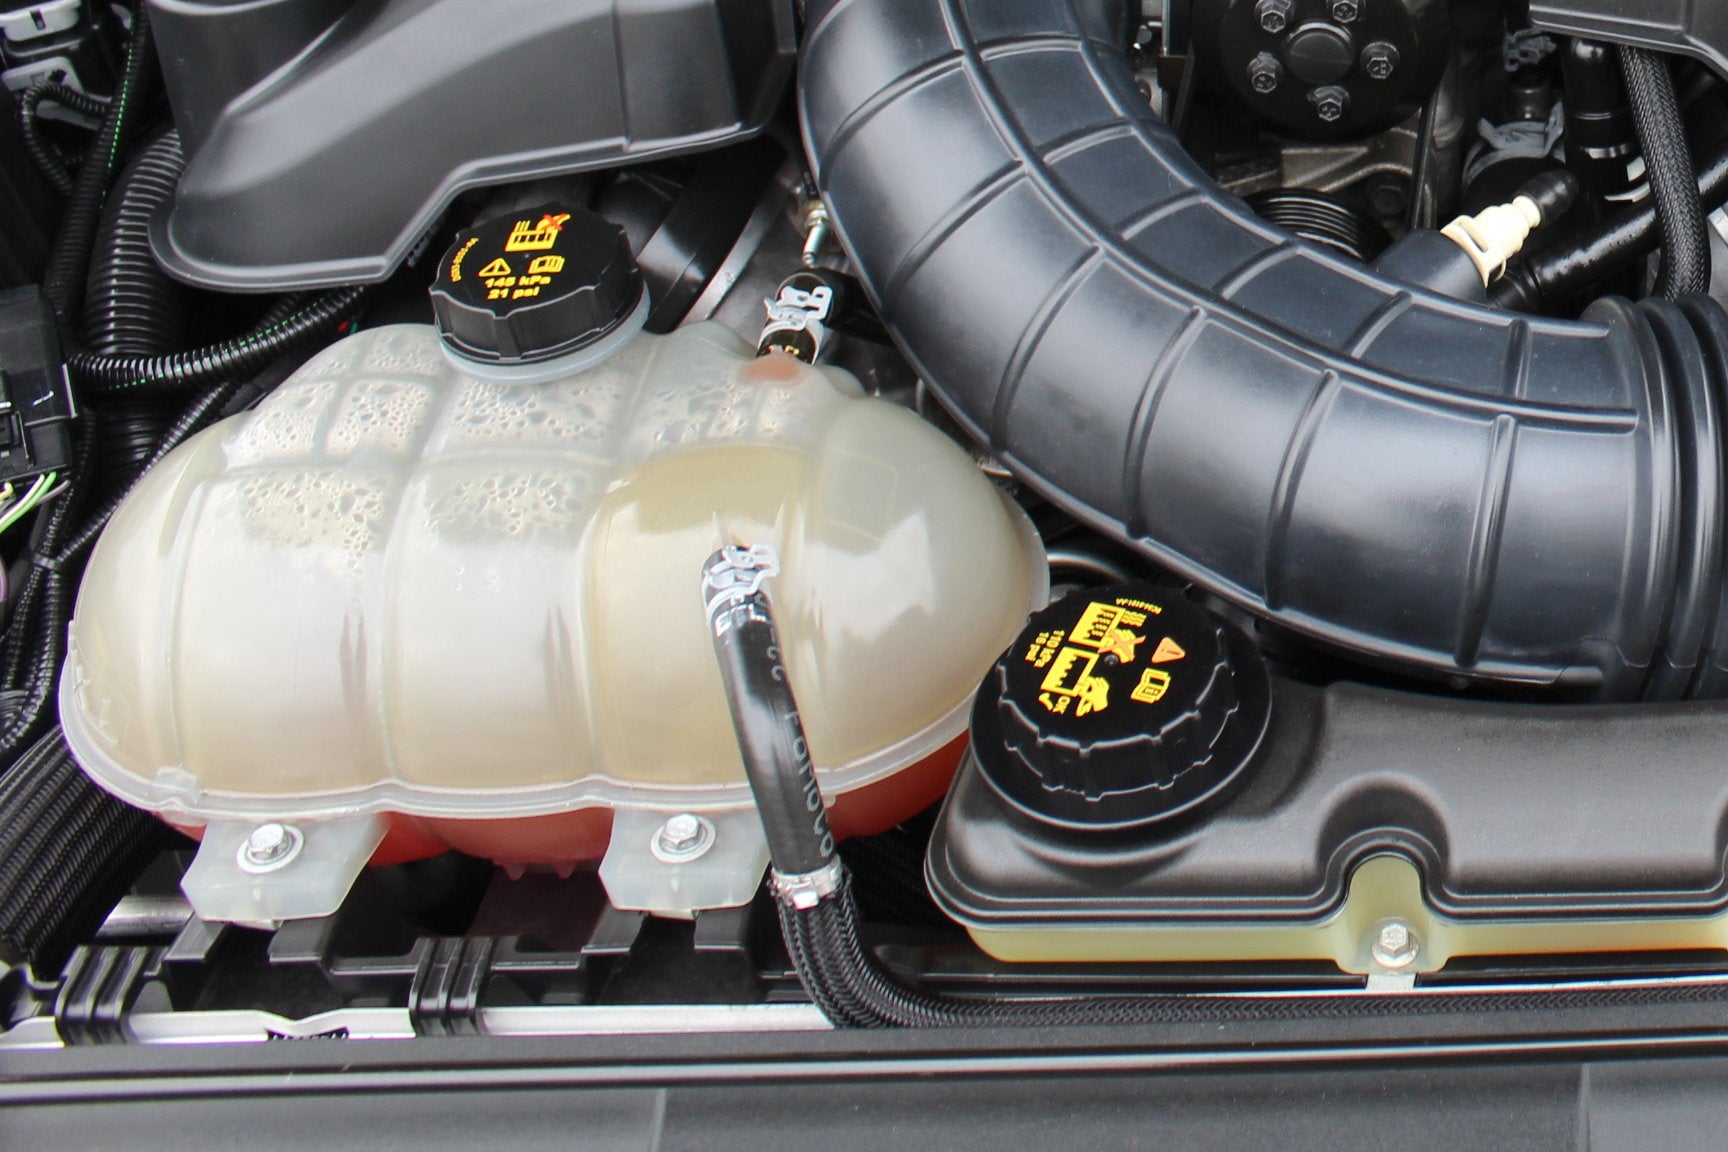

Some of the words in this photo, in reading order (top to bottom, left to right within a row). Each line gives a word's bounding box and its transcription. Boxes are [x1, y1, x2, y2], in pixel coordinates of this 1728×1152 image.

[485, 277, 516, 288] 145
[518, 275, 551, 286] kPa
[487, 288, 509, 300] 21
[512, 286, 541, 299] psi
[1035, 632, 1049, 645] 16
[1046, 630, 1065, 649] 110
[1053, 696, 1071, 714] OK
